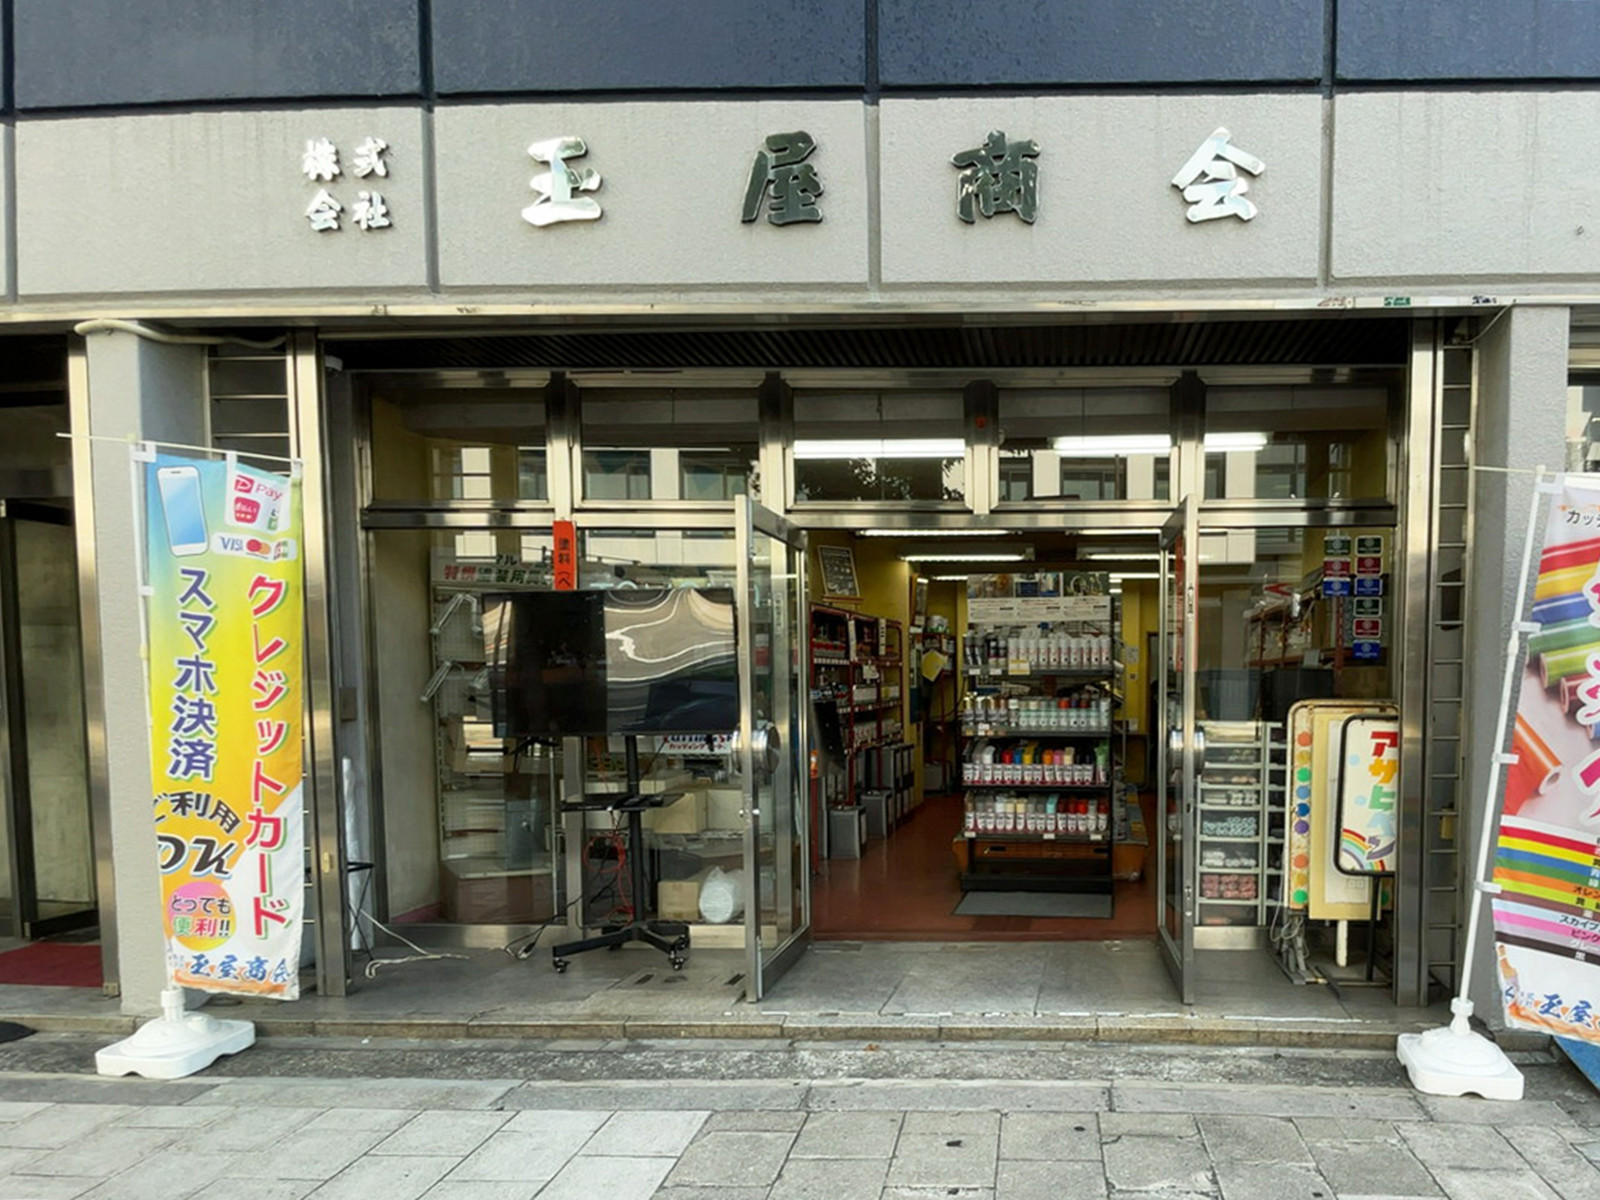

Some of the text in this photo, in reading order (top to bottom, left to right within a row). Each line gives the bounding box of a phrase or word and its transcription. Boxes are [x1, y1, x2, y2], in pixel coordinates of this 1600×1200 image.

[303, 136, 388, 180] 株式
[306, 189, 392, 231] 会社
[1566, 510, 1600, 528] カッ
[169, 568, 216, 779] スマホ決済
[246, 575, 288, 937] クレジットカード
[172, 895, 231, 914] とっても
[174, 916, 231, 937] 便利!!
[190, 953, 290, 982] 玉屋商会
